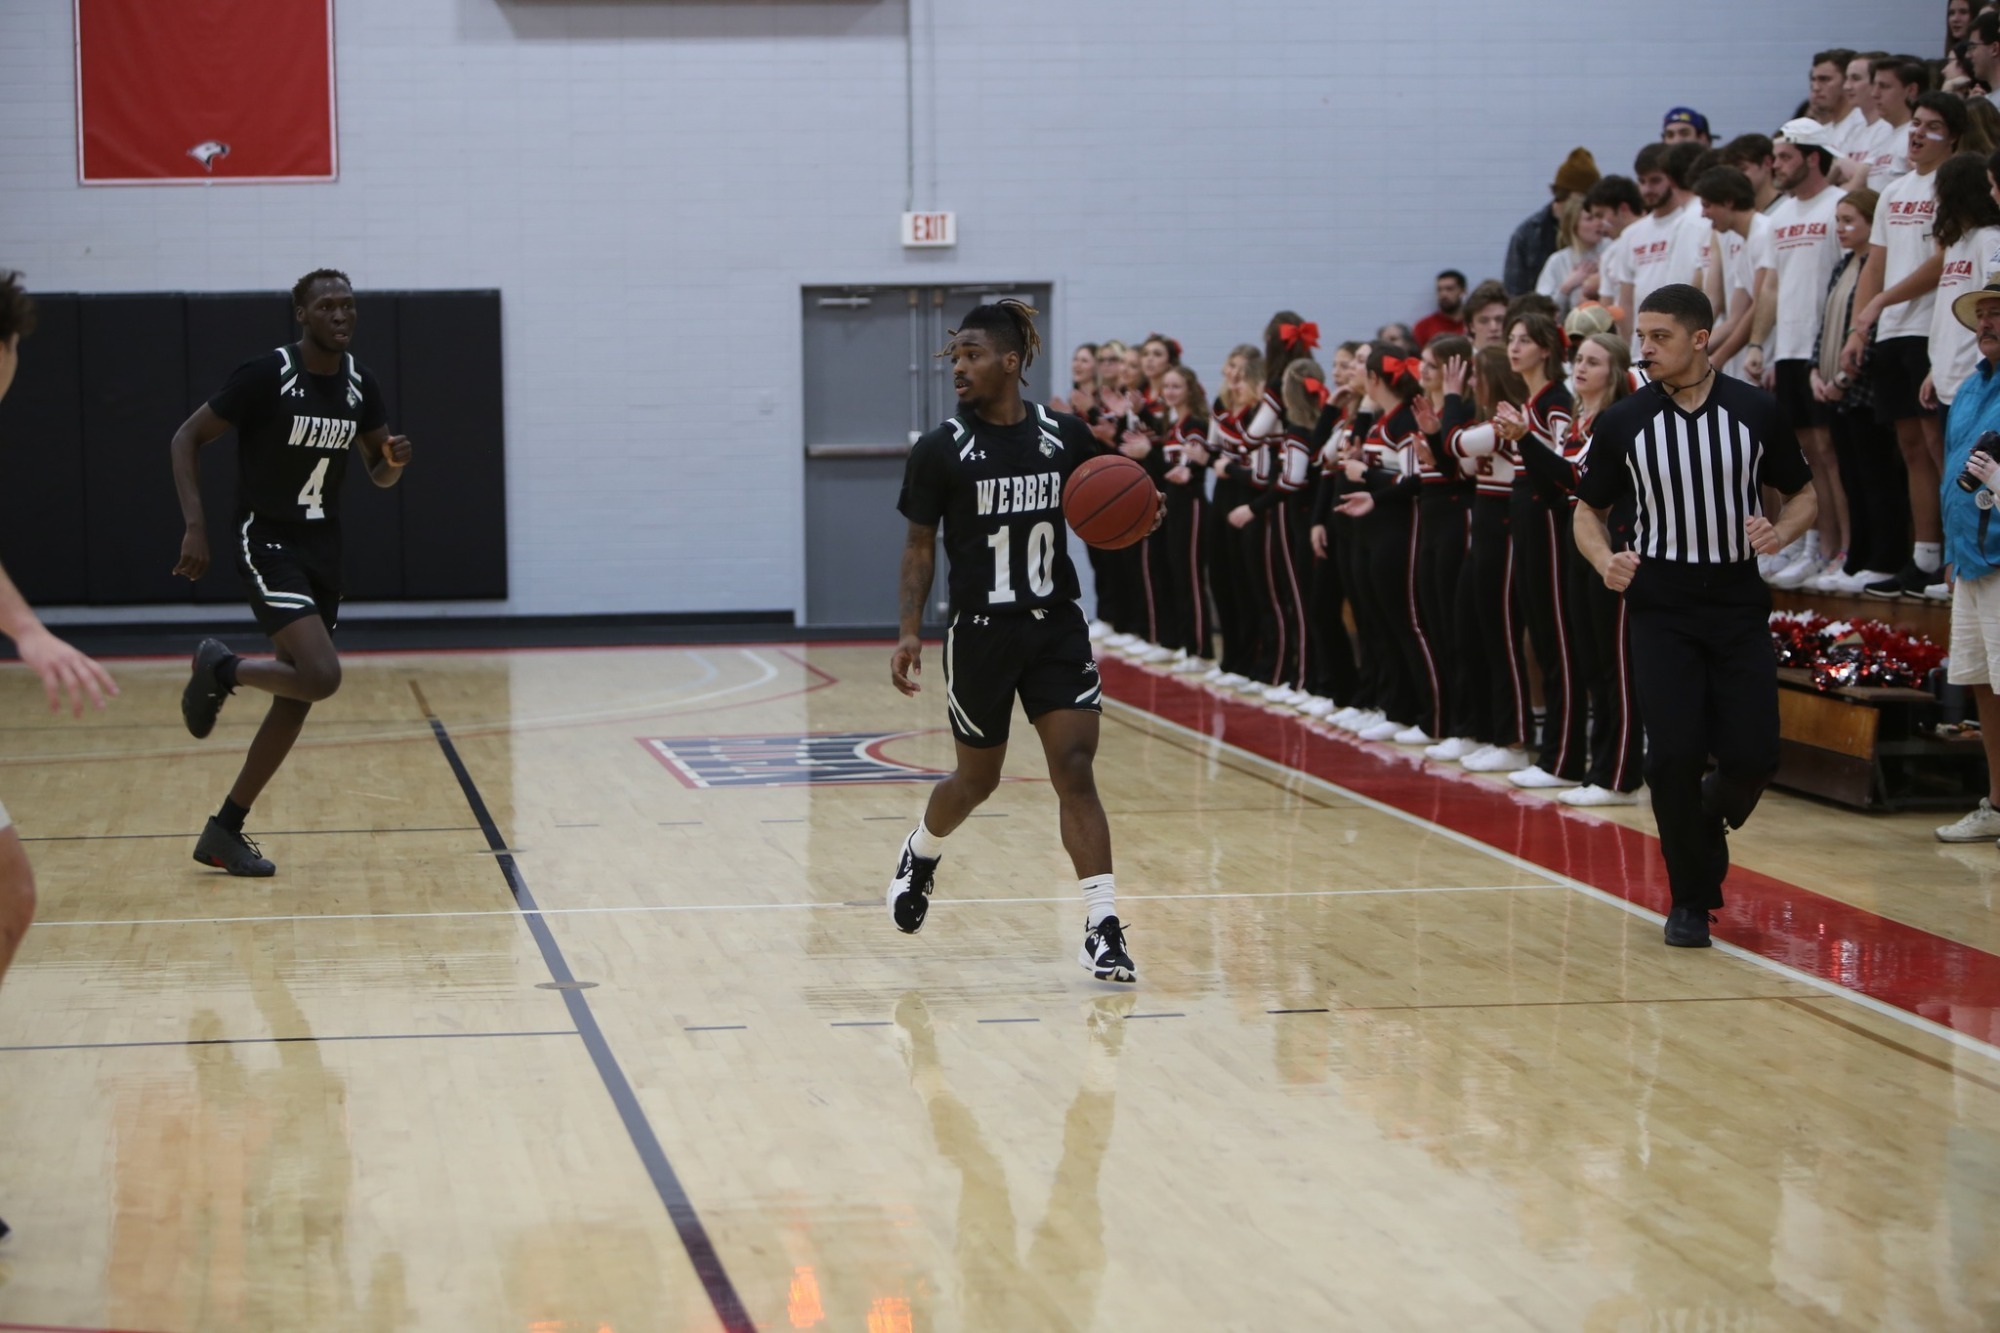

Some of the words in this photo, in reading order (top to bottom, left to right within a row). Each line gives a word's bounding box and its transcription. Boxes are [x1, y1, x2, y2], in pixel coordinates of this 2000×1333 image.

[913, 214, 947, 241] EXIT
[1807, 222, 1827, 235] SEA
[288, 415, 357, 450] WEBBER
[297, 457, 330, 519] 4
[976, 472, 1061, 515] WEBBER
[987, 521, 1055, 604] 10
